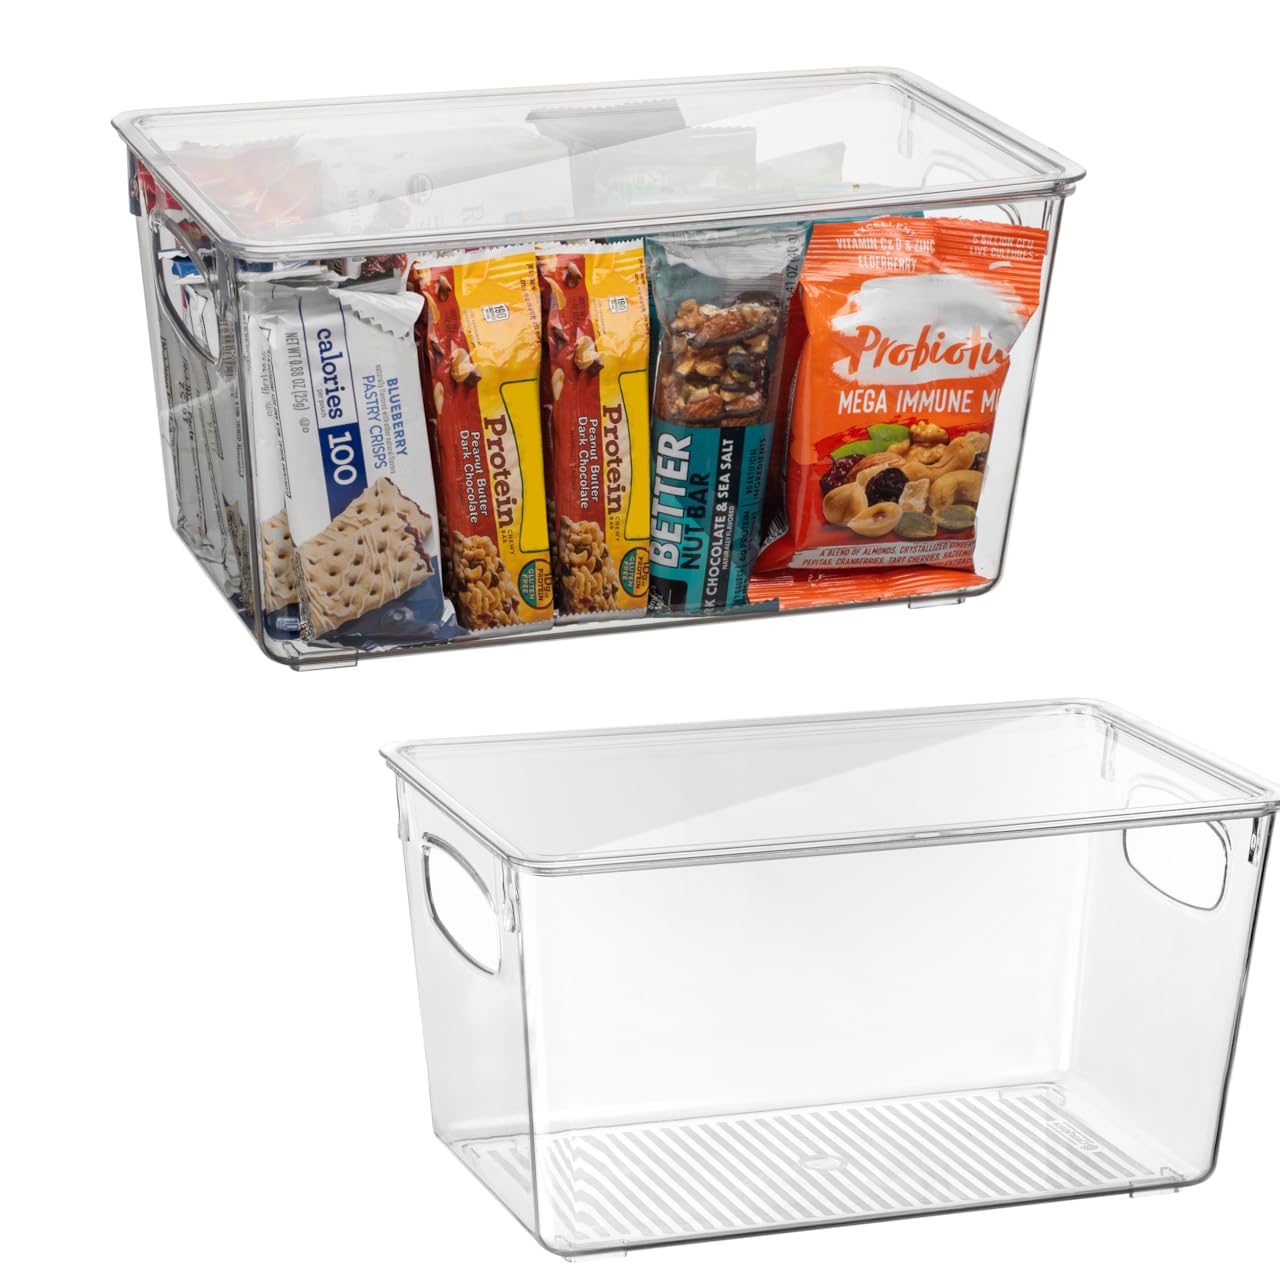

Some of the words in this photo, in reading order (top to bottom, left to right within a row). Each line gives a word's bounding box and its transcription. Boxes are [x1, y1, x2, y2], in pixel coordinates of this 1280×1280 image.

[836, 238, 877, 250] VITAMIN
[858, 255, 917, 273] ELDERBERRY
[285, 332, 300, 346] NET
[287, 346, 302, 360] WT
[290, 360, 305, 377] 0.88
[292, 378, 307, 390] OZ
[317, 328, 346, 420] calories
[290, 390, 310, 411] (25g)
[362, 374, 381, 422] PASTRY
[838, 389, 887, 416] MEGA
[896, 389, 974, 414] IMMUNE
[387, 377, 408, 457] BLUEBERRY
[577, 416, 589, 446] Dark
[369, 424, 388, 469] CRISPS
[459, 429, 471, 460] Dark
[470, 430, 485, 474] Peanut
[588, 418, 599, 462] Peanut
[720, 438, 735, 470] SALT
[328, 431, 358, 486] 100
[484, 414, 518, 529] Protein
[602, 403, 625, 515] Protein
[463, 463, 479, 524] Chocolate
[578, 449, 589, 510] Chocolate
[590, 465, 601, 503] Butter
[687, 472, 710, 519] BAR
[717, 473, 731, 499] SEA
[477, 478, 489, 517] Butter
[650, 431, 692, 568] BETTER
[716, 501, 728, 512] &
[726, 505, 735, 537] FLAVORED
[507, 528, 516, 556] CHEWY
[681, 523, 705, 571] NUT
[706, 515, 727, 596] CHOCOLATE
[722, 536, 732, 570] NATURALLY
[827, 549, 849, 557] BLEND
[627, 555, 635, 588] GLUTEN
[635, 556, 643, 590] PROTEIN
[888, 556, 906, 565] TART
[521, 573, 529, 594] FREE
[528, 567, 536, 601] GLUTEN
